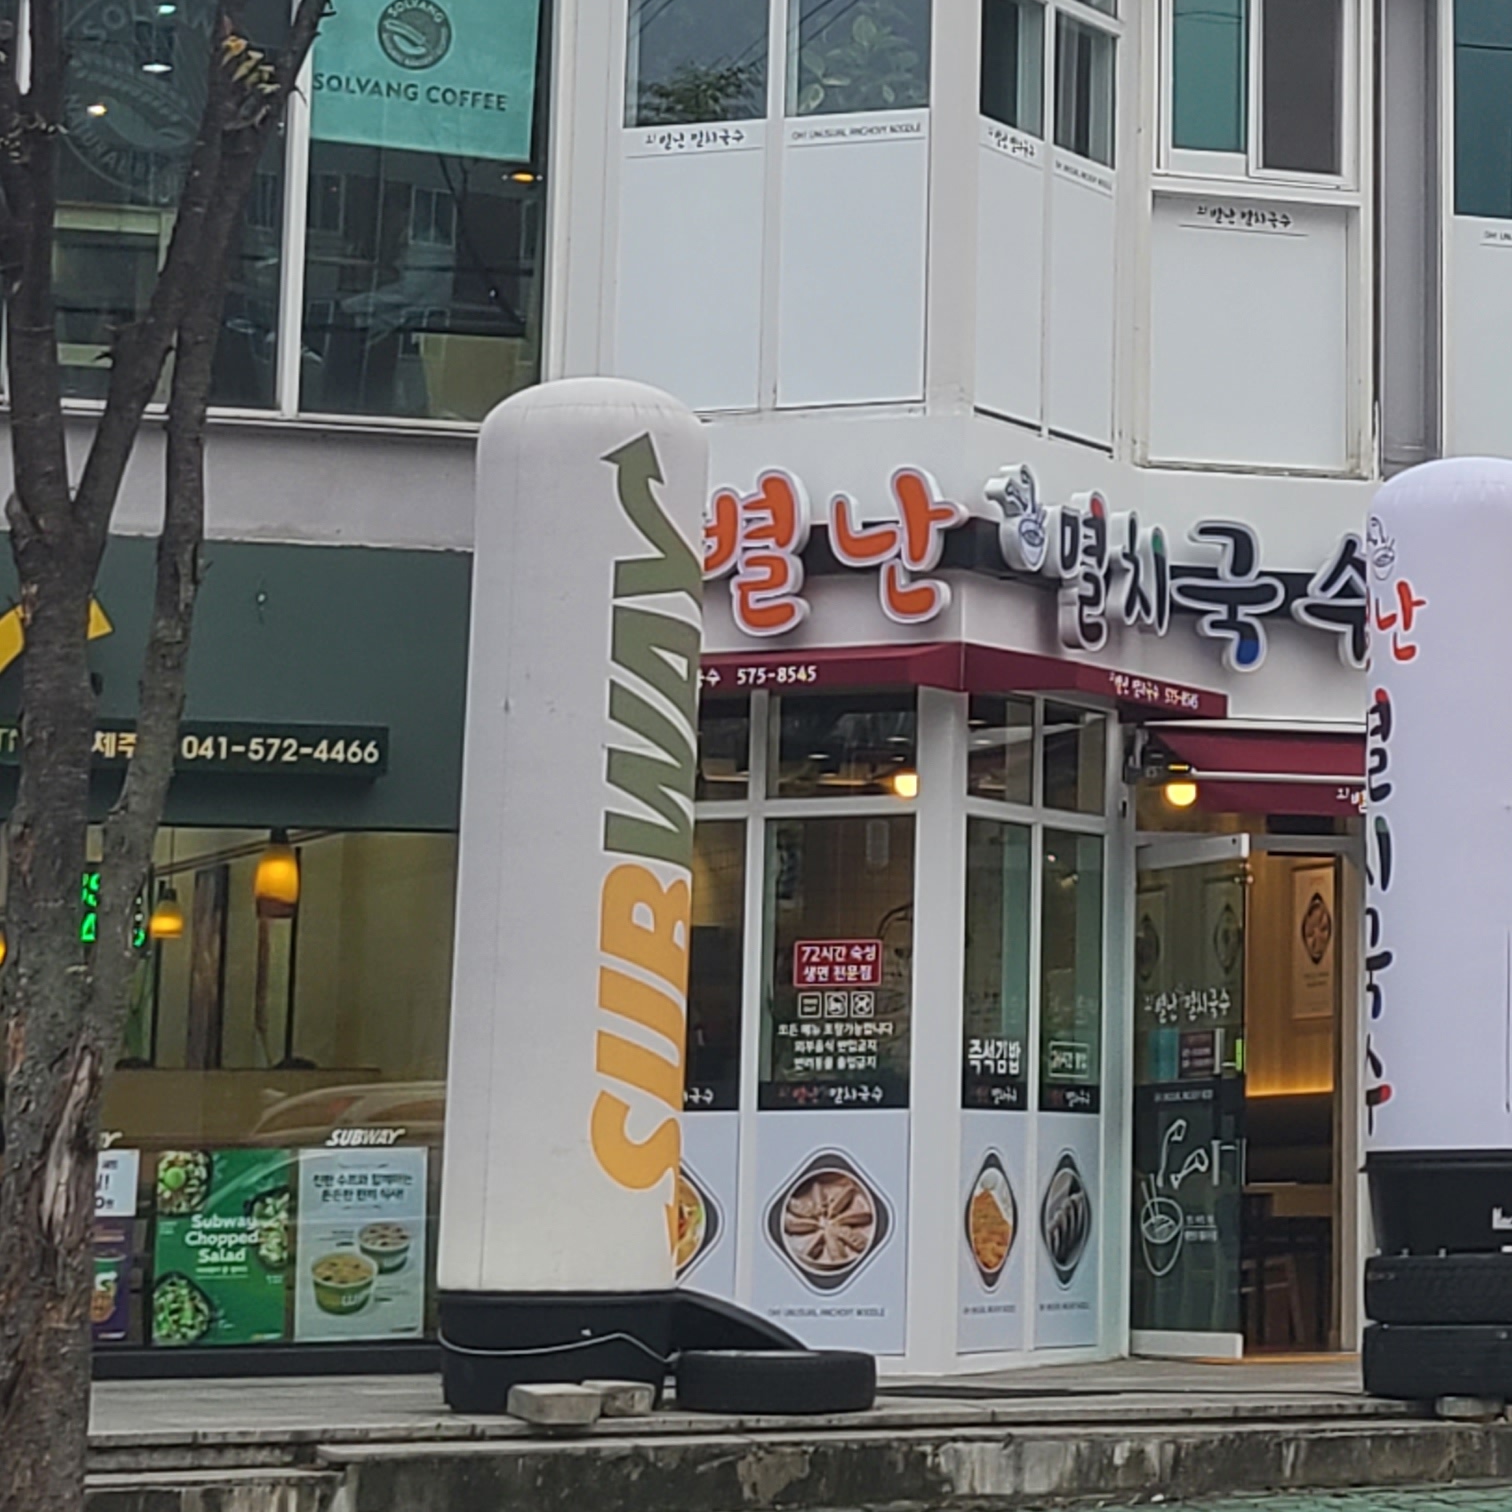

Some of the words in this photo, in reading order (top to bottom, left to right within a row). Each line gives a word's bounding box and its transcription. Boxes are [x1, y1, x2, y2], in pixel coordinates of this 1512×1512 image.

[313, 73, 419, 101] SOLVANG
[426, 86, 508, 112] COFFEE
[736, 665, 817, 685] 575-8545
[182, 735, 380, 764] 041-572-4466
[590, 432, 705, 1258] SUBWAY
[801, 946, 847, 962] 72시간
[851, 944, 877, 961] 숙성
[325, 1129, 406, 1146] SUBWAY
[191, 1214, 257, 1231] Subway
[185, 1231, 259, 1248] Chopped
[197, 1248, 246, 1263] Salad
